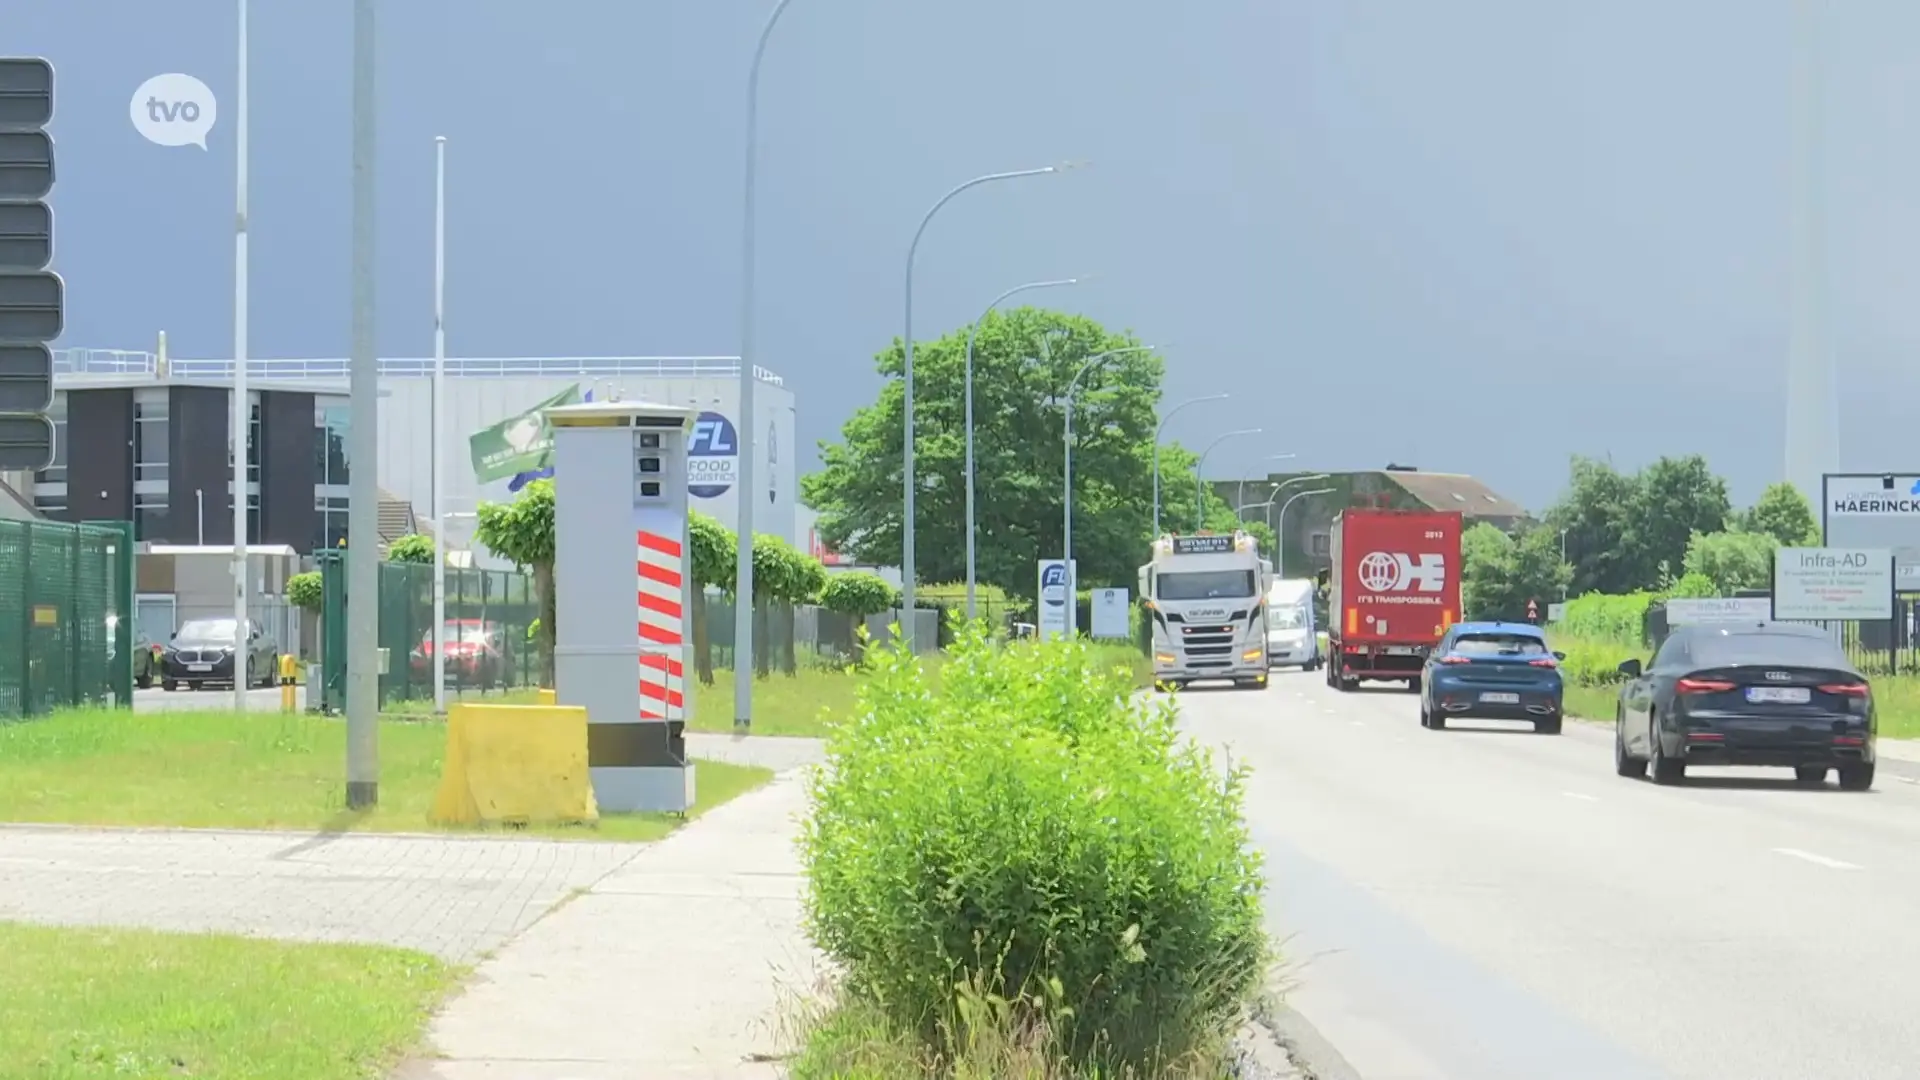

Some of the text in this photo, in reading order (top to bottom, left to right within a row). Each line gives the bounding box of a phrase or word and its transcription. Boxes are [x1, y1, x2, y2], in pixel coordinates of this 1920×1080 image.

[688, 460, 731, 472] FOOD
[688, 472, 736, 482] OGISTICS
[1834, 499, 1920, 513] HAERINCK
[1800, 552, 1868, 568] Infra-AD
